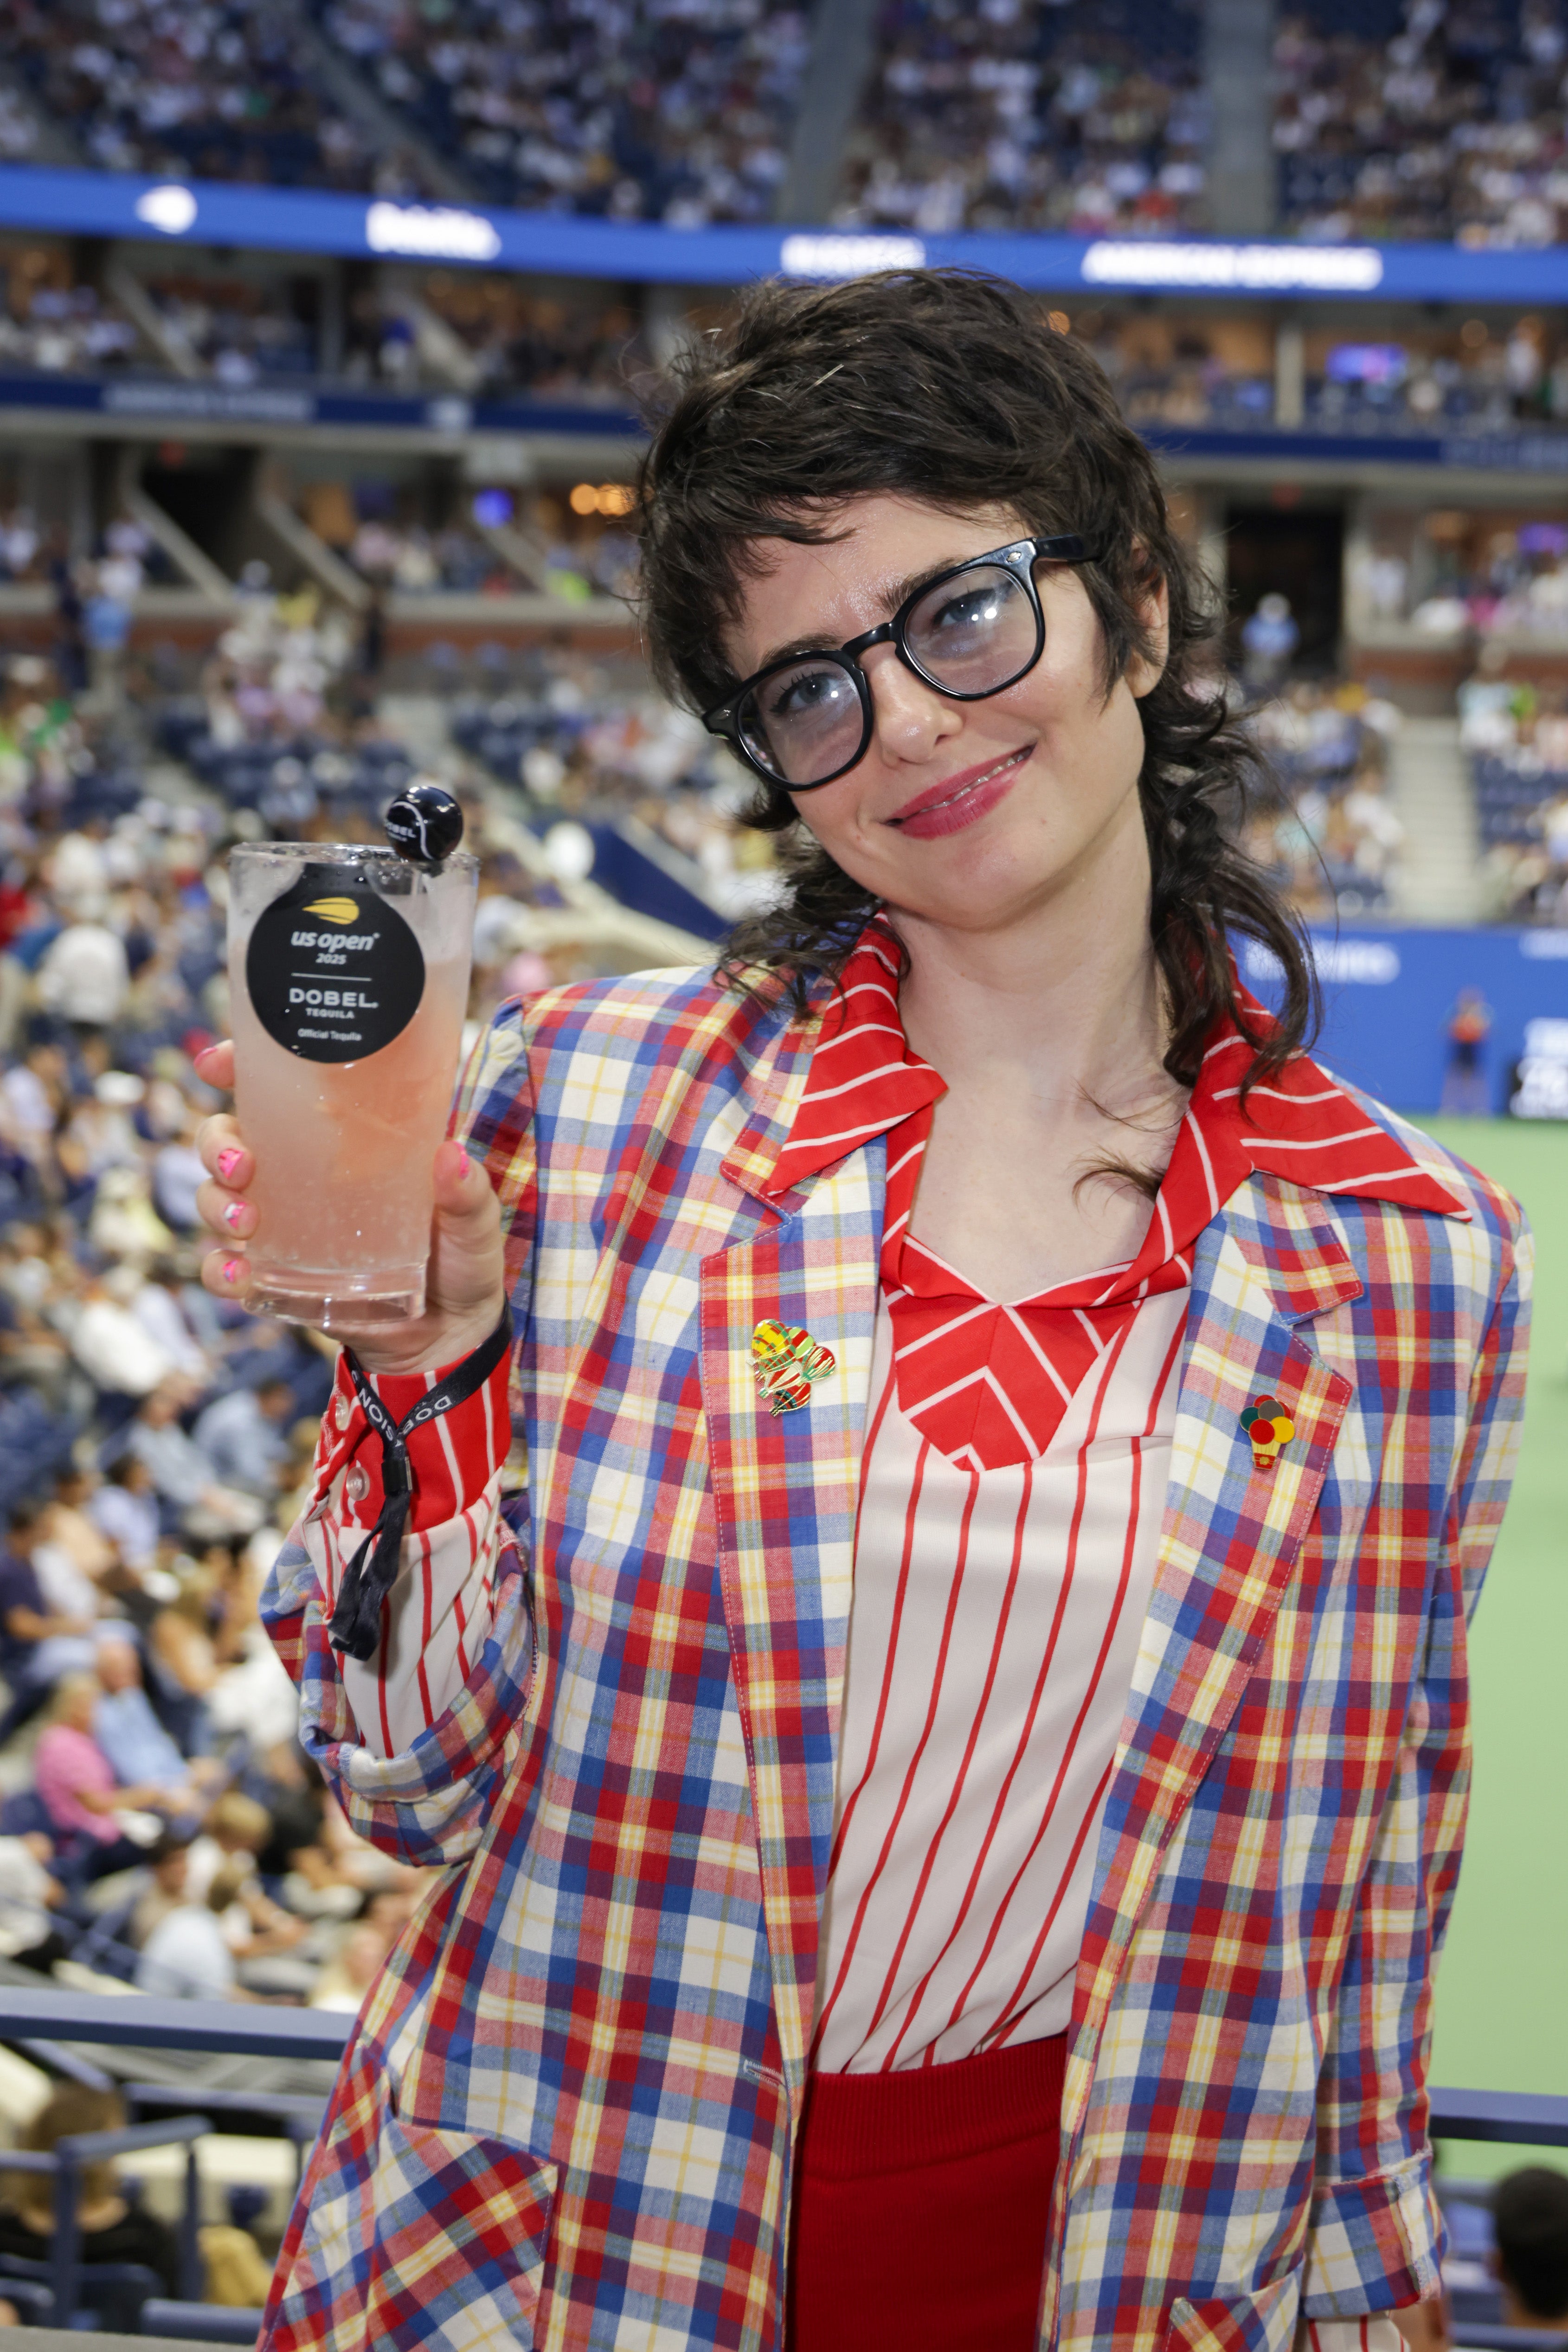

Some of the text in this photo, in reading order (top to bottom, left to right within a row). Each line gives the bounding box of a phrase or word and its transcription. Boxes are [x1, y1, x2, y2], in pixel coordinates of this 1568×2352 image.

[291, 931, 375, 953] us open
[315, 953, 347, 965] 2025
[305, 1007, 355, 1019] TEQUILA
[297, 1028, 362, 1041] Official Tequila
